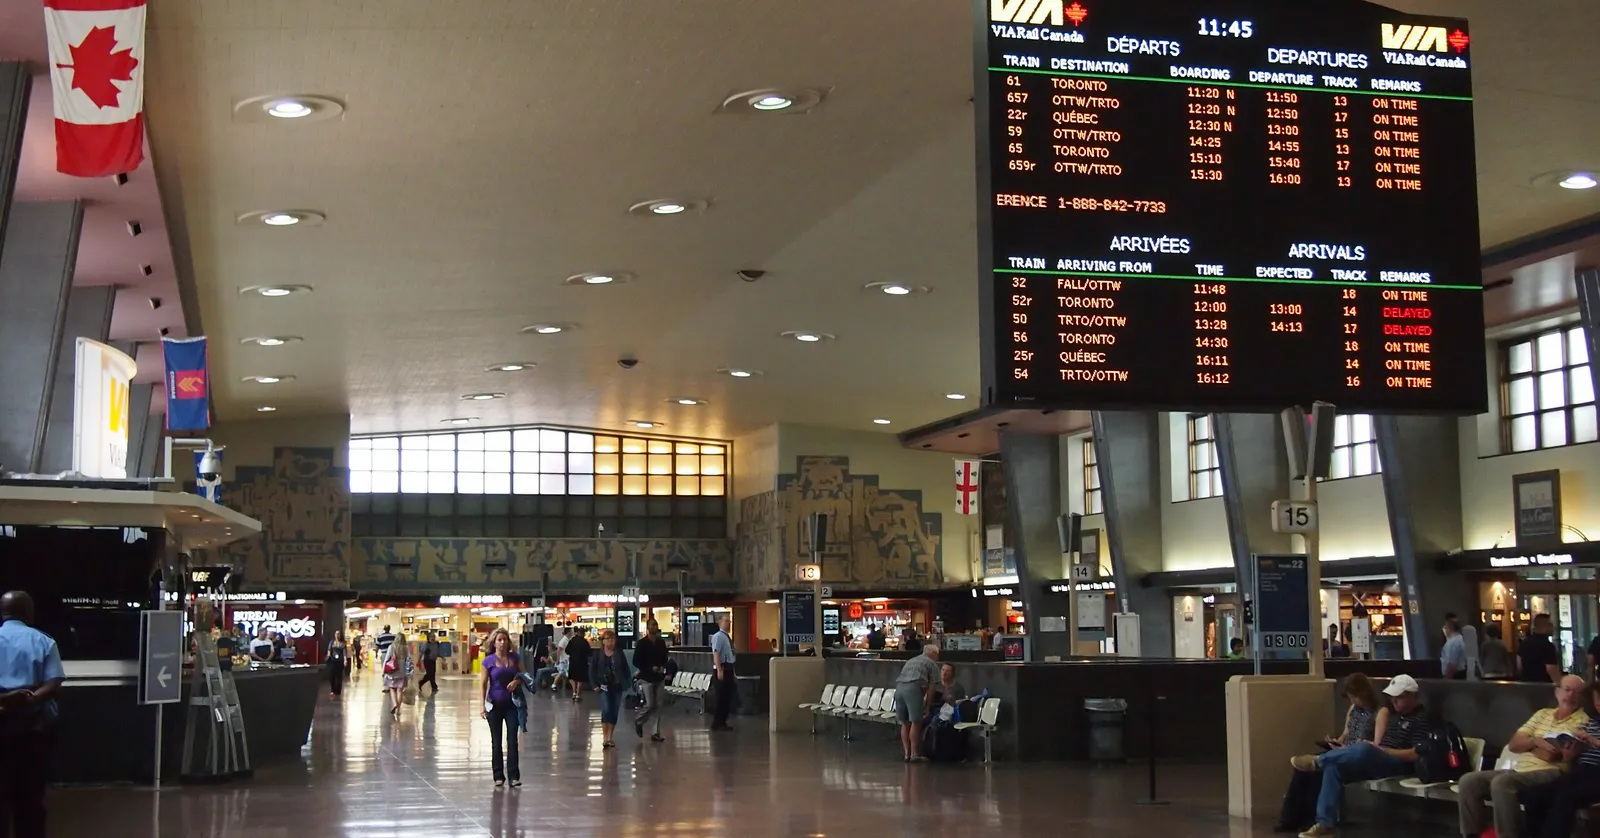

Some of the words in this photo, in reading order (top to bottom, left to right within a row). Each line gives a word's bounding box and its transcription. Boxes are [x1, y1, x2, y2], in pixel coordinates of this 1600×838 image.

[991, 0, 1064, 27] VIA
[1040, 28, 1084, 43] Canada
[1198, 18, 1253, 38] 11:45
[1108, 35, 1181, 56] DÉPARTS
[1382, 24, 1448, 53] VIA
[1268, 48, 1368, 68] DEPARTURES
[1427, 55, 1467, 68] Canada
[1003, 55, 1040, 68] TRAIN
[1050, 58, 1128, 74] DESTINATION
[1170, 66, 1230, 80] BOARDING
[1248, 71, 1313, 86] DEPARTURE
[1322, 76, 1357, 88] TRACK
[1370, 79, 1421, 93] REMARKS
[1007, 76, 1021, 86] 61
[1051, 77, 1108, 91] TORONTO
[1188, 87, 1219, 98] 11:20
[1227, 89, 1234, 99] N
[1266, 92, 1297, 103] 11:50
[1334, 96, 1347, 106] 13
[1373, 98, 1388, 108] ON
[1392, 99, 1417, 110] TIME
[1008, 92, 1028, 103] 657
[1053, 95, 1119, 108] OTTW/TRTO
[1188, 103, 1220, 115] 12:20
[1227, 106, 1235, 116] N
[1267, 108, 1298, 119] 12:50
[1335, 112, 1347, 122] 17
[1373, 114, 1389, 124] ON
[1392, 115, 1418, 126] TIME
[1008, 109, 1027, 120] 22r
[1053, 110, 1098, 124] QUÉBEC
[1189, 120, 1220, 131] 12:30
[1224, 122, 1232, 132] N
[1268, 124, 1298, 135] 13:00
[1336, 128, 1348, 138] 15
[1374, 130, 1390, 140] ON
[1393, 131, 1419, 142] TIME
[1008, 126, 1022, 136] 59
[1054, 129, 1120, 142] OTTW/TRTO
[1190, 136, 1221, 147] 14:25
[1268, 141, 1299, 151] 14:55
[1336, 144, 1350, 154] 13
[1375, 146, 1391, 156] ON
[1394, 147, 1419, 158] TIME
[1009, 143, 1022, 153] 65
[1053, 145, 1109, 158] TORONTO
[1190, 153, 1222, 164] 15:10
[1269, 157, 1300, 168] 15:40
[1337, 161, 1350, 170] 17
[1375, 162, 1392, 172] ON
[1394, 163, 1420, 174] TIME
[1009, 160, 1036, 170] 659r
[1055, 162, 1121, 175] OTTW/TRTO
[1191, 169, 1222, 180] 15:30
[1270, 173, 1301, 184] 16:00
[1338, 177, 1351, 187] 13
[1376, 178, 1392, 189] ON
[1395, 179, 1421, 190] TIME
[1059, 197, 1166, 213] 1-888-842-7733
[1110, 235, 1190, 253] ARRIVÉES
[1289, 243, 1366, 260] ARRIVALS
[1008, 257, 1045, 269] TRAIN
[1057, 259, 1116, 271] ARRIVING
[1120, 262, 1152, 273] FROM
[1195, 264, 1223, 275] TIME
[1256, 267, 1313, 280] EXPECTED
[1331, 269, 1367, 280] TRACK
[1380, 271, 1430, 283] REMARKS
[1012, 277, 1026, 287] 32
[1058, 279, 1121, 291] FALL/OTTW
[1194, 284, 1226, 294] 11:48
[1343, 289, 1356, 299] 18
[1382, 290, 1399, 300] ON
[1401, 291, 1427, 301] TIME
[1013, 296, 1032, 306] 52r
[1058, 297, 1114, 308] TORONTO
[1194, 301, 1226, 312] 12:00
[1270, 304, 1302, 315] 13:00
[1343, 306, 1357, 316] 14
[1383, 307, 1432, 319] DELAYED
[1013, 313, 1027, 324] 50
[1058, 315, 1126, 327] TRTO/OTTW
[1195, 319, 1227, 330] 13:28
[1271, 321, 1303, 332] 14:13
[1344, 324, 1357, 333] 17
[1384, 324, 1432, 336] DELAYED
[1014, 332, 1028, 342] 56
[1059, 333, 1115, 345] TORONTO
[1196, 337, 1228, 348] 14:30
[1345, 341, 1359, 351] 18
[1385, 342, 1401, 352] ON
[1403, 342, 1430, 353] TIME
[1014, 350, 1034, 360] 25r
[1060, 349, 1106, 363] QUÉBEC
[1197, 355, 1228, 366] 16:11
[1346, 359, 1359, 369] 14
[1385, 360, 1402, 370] ON
[1404, 360, 1431, 370] TIME
[1015, 368, 1028, 379] 54
[1060, 369, 1128, 381] TRTO/OTTW
[1197, 373, 1229, 383] 16:12
[1347, 376, 1360, 386] 16
[1386, 377, 1403, 387] ON
[1406, 377, 1432, 388] TIME
[1285, 507, 1309, 527] 15
[801, 568, 815, 579] 13
[1075, 567, 1088, 577] 14
[1292, 560, 1304, 569] 22
[229, 593, 267, 601] NATIONALE
[536, 598, 541, 606] 9
[628, 588, 637, 596] 11
[683, 598, 692, 606] 10
[233, 611, 277, 621] BUREAU
[1265, 635, 1307, 647] 1300
